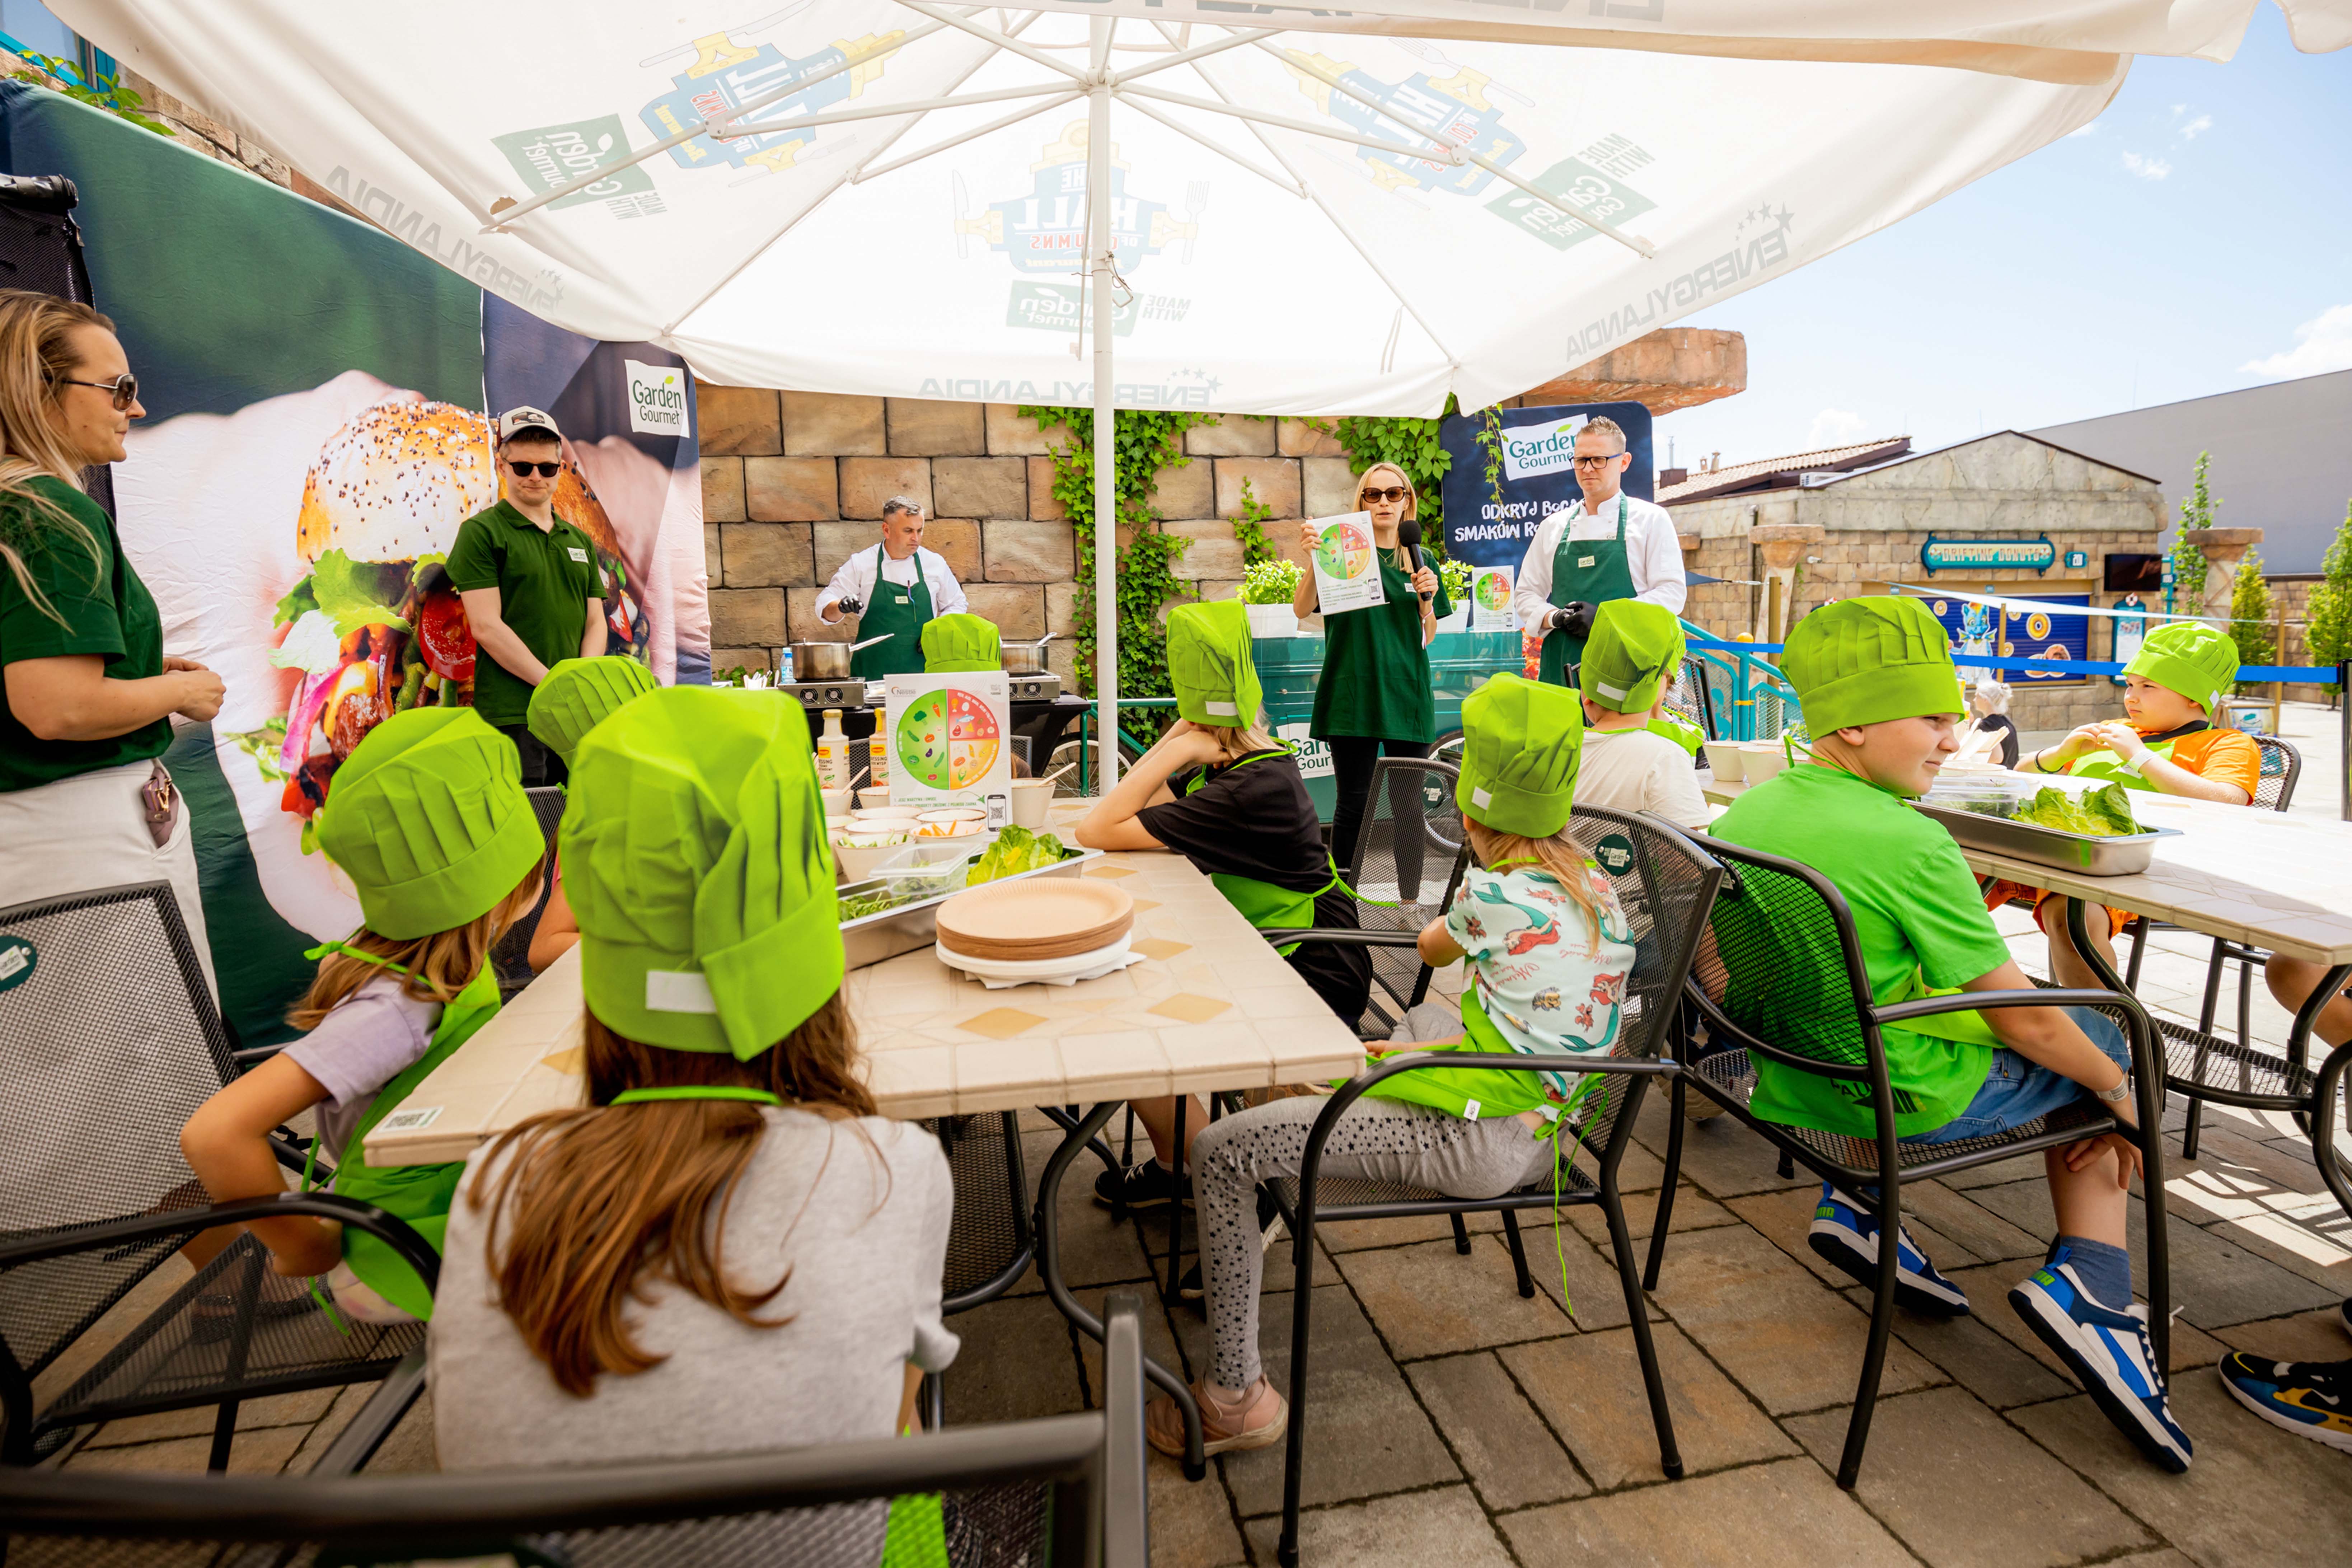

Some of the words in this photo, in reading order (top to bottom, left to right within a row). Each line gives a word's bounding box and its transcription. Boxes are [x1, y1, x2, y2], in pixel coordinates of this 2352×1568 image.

[633, 380, 682, 410] Garden
[640, 405, 680, 425] Gourmet
[1519, 451, 1574, 469] Gourme
[1481, 501, 1538, 520] ODKRYJ
[1454, 520, 1520, 542] SMAKÓW
[1942, 548, 1993, 562] DRIFTING
[1297, 756, 1331, 770] Gour
[1559, 949, 1612, 965] Memaids
